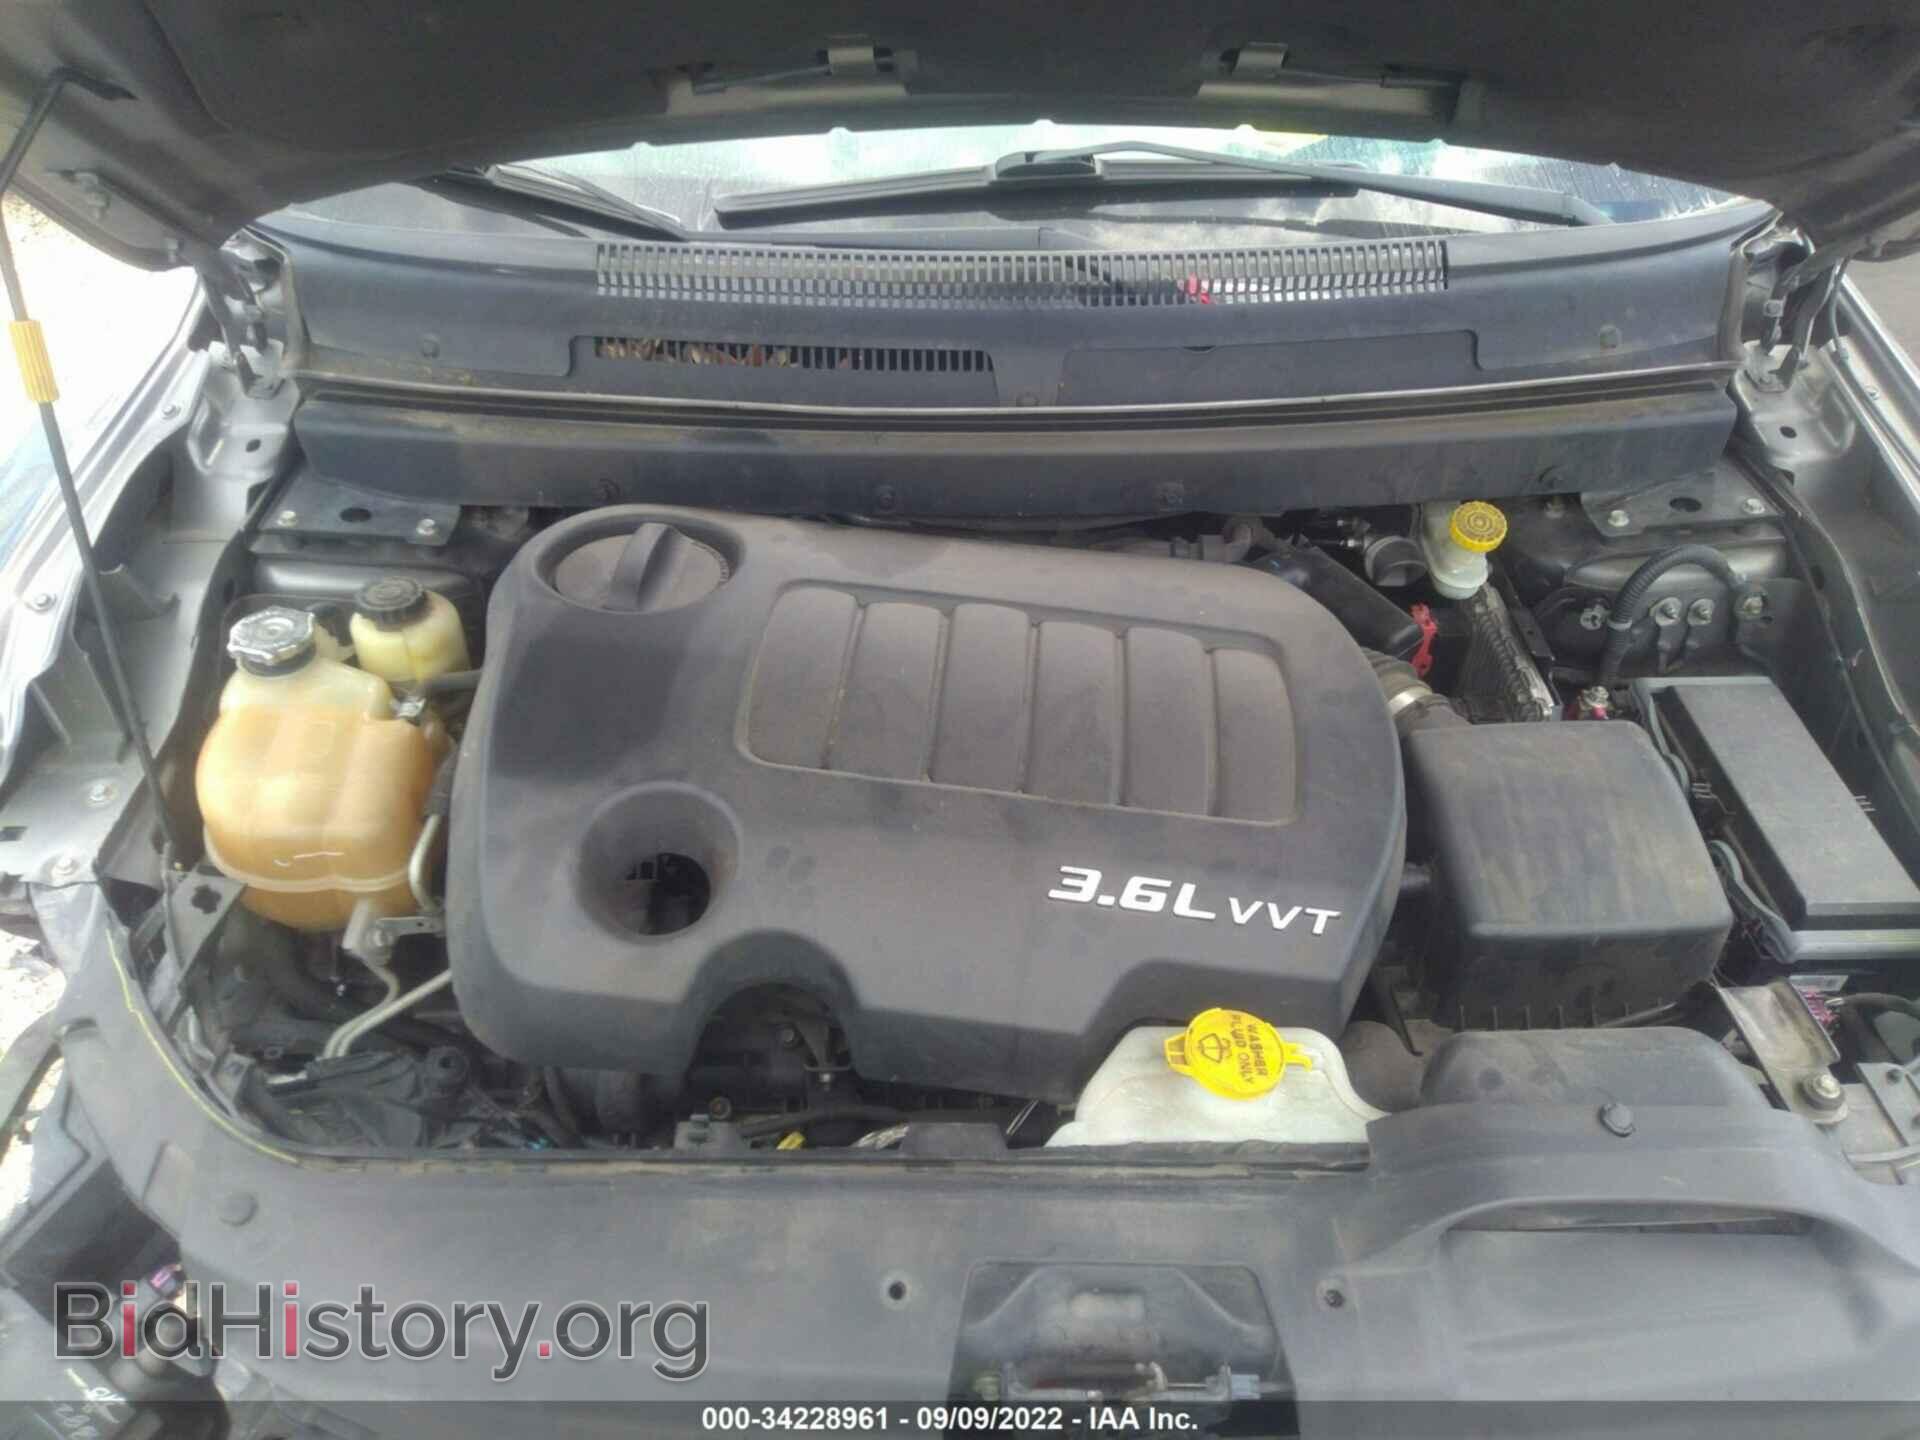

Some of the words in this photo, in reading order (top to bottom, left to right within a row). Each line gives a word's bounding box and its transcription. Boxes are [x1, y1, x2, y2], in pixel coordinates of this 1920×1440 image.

[1048, 866, 1216, 920] 3.6L
[1229, 897, 1342, 935] VVT
[1237, 1052, 1255, 1084] ONLY
[1247, 1023, 1268, 1077] WASHER
